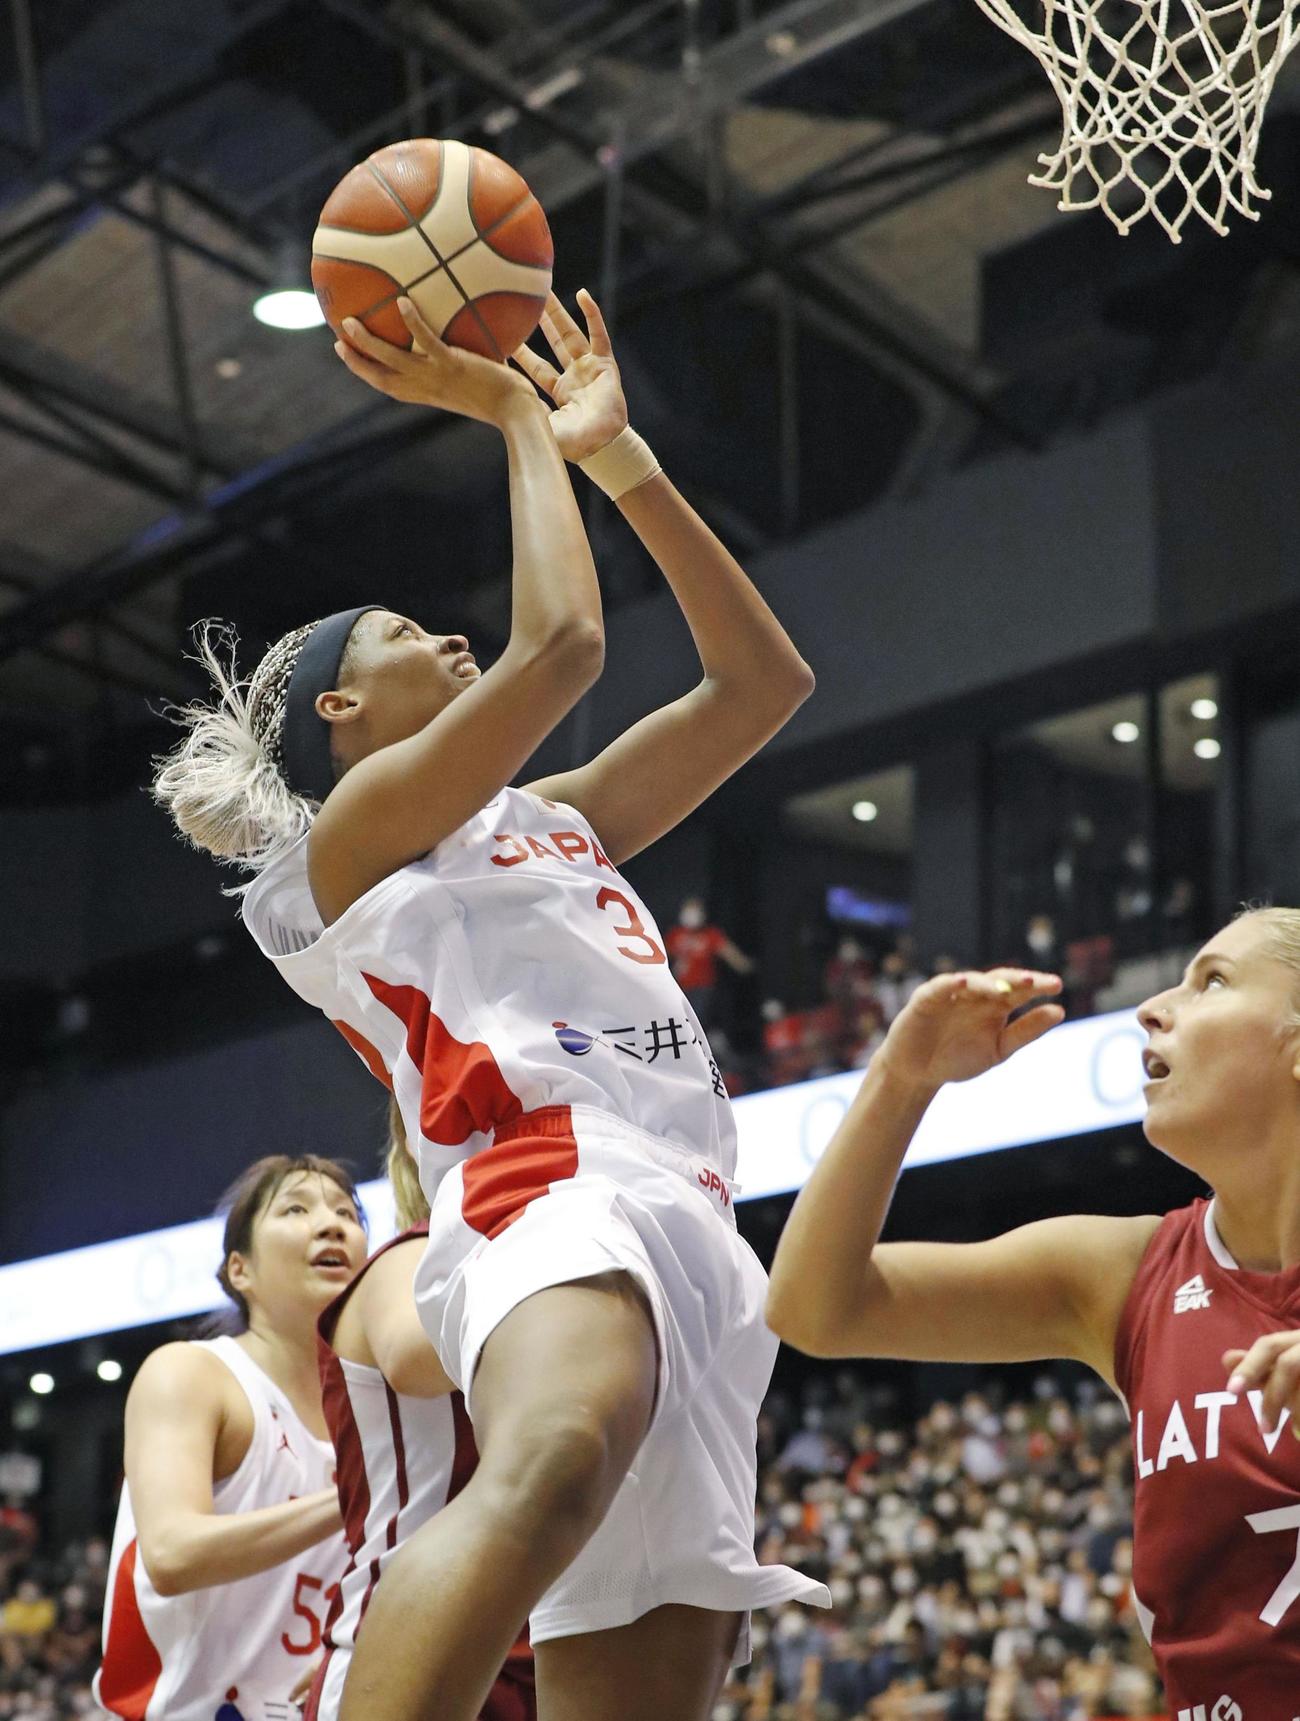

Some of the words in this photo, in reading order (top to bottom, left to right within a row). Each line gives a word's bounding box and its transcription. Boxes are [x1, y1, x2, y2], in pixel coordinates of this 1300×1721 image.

[596, 886, 666, 964] 3
[698, 1167, 730, 1207] JPN
[1244, 1503, 1300, 1628] 7
